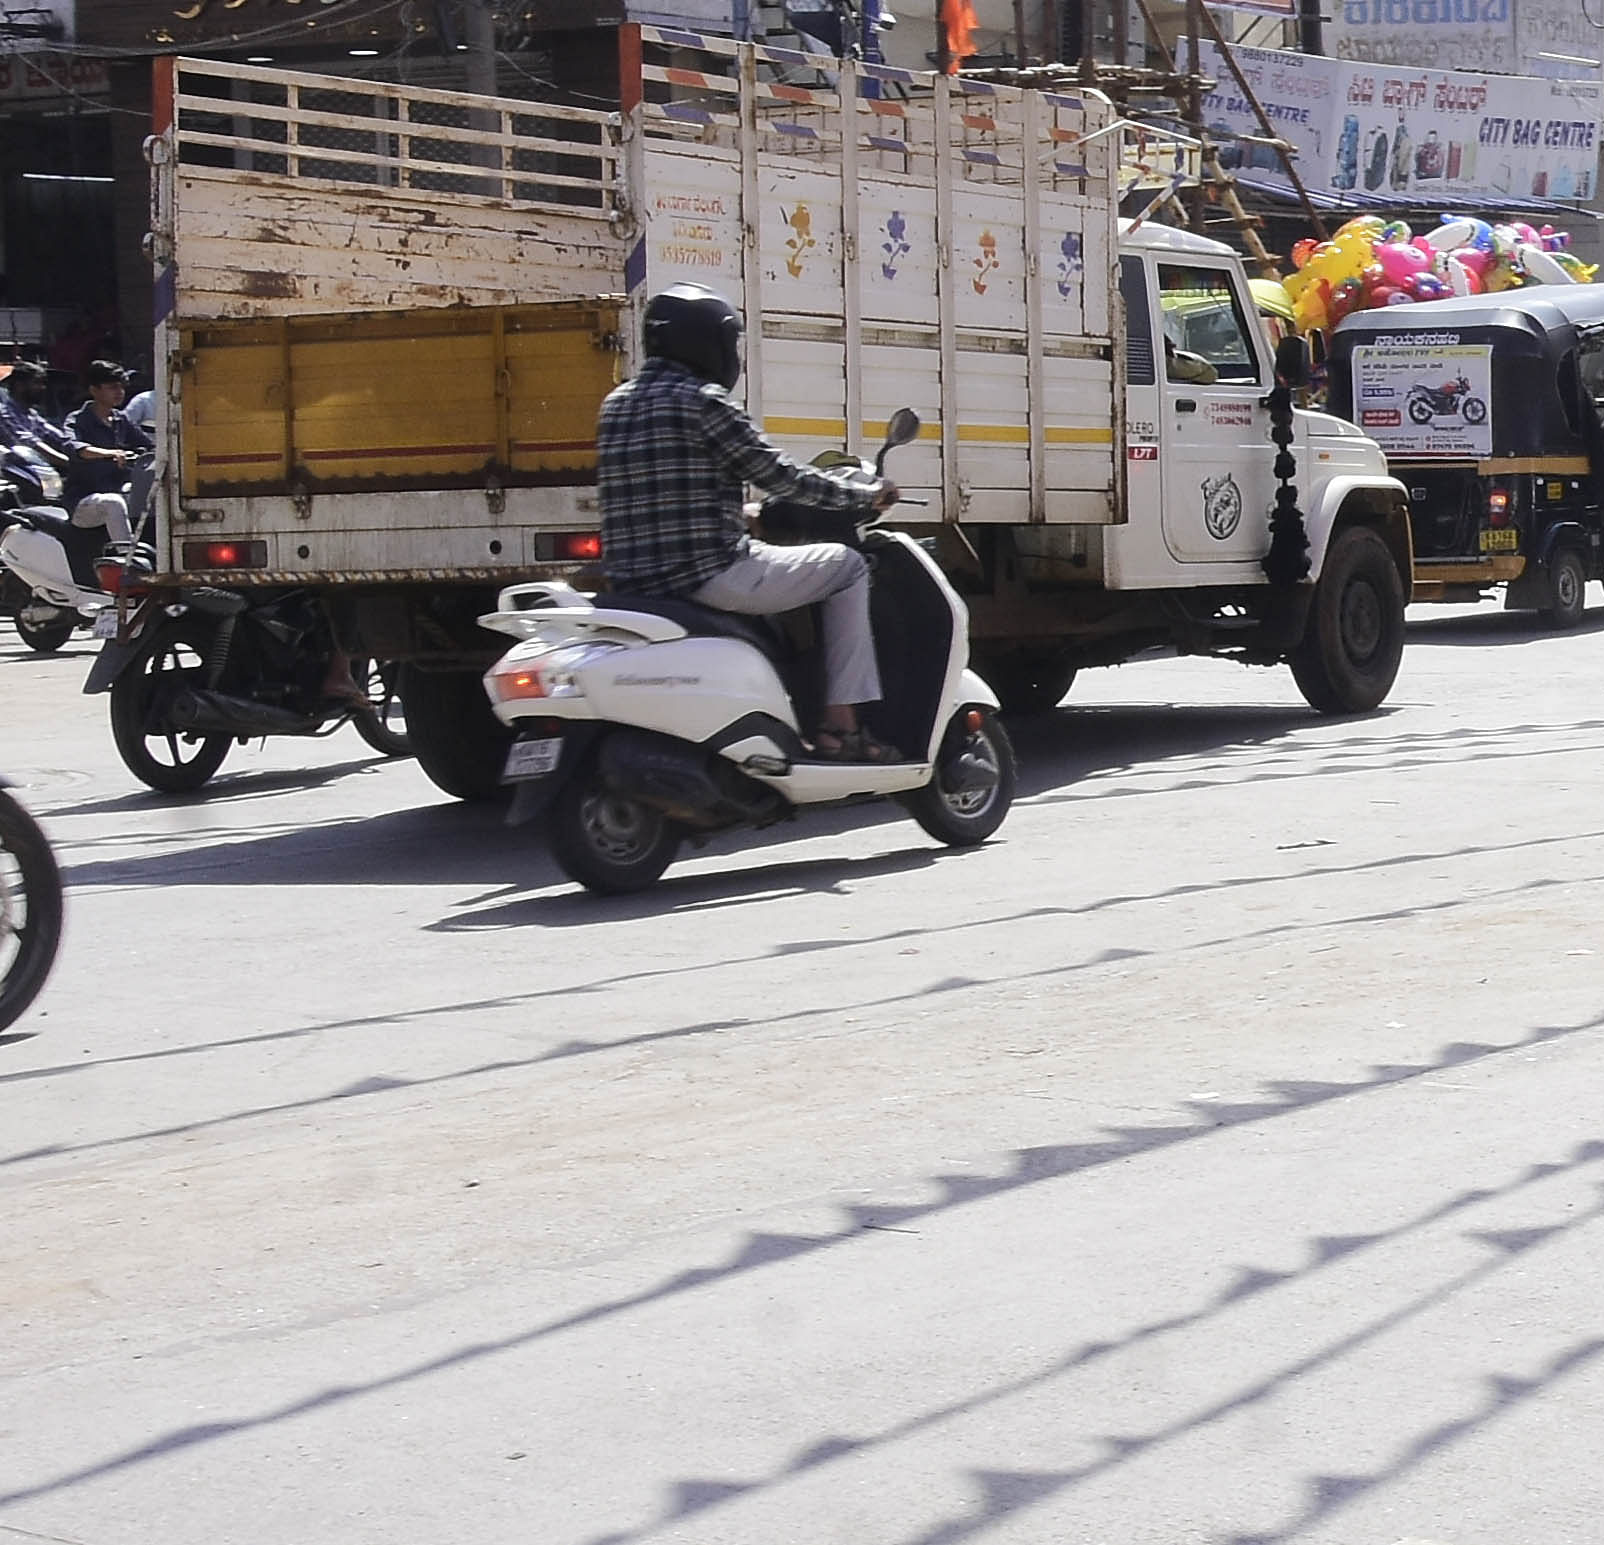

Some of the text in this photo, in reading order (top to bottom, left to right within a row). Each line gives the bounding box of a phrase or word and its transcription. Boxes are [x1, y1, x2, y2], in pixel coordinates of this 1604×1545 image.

[1262, 102, 1310, 123] ENTRE
[1479, 116, 1596, 147] CITY BAG CENTRE
[1126, 422, 1154, 435] OLERO
